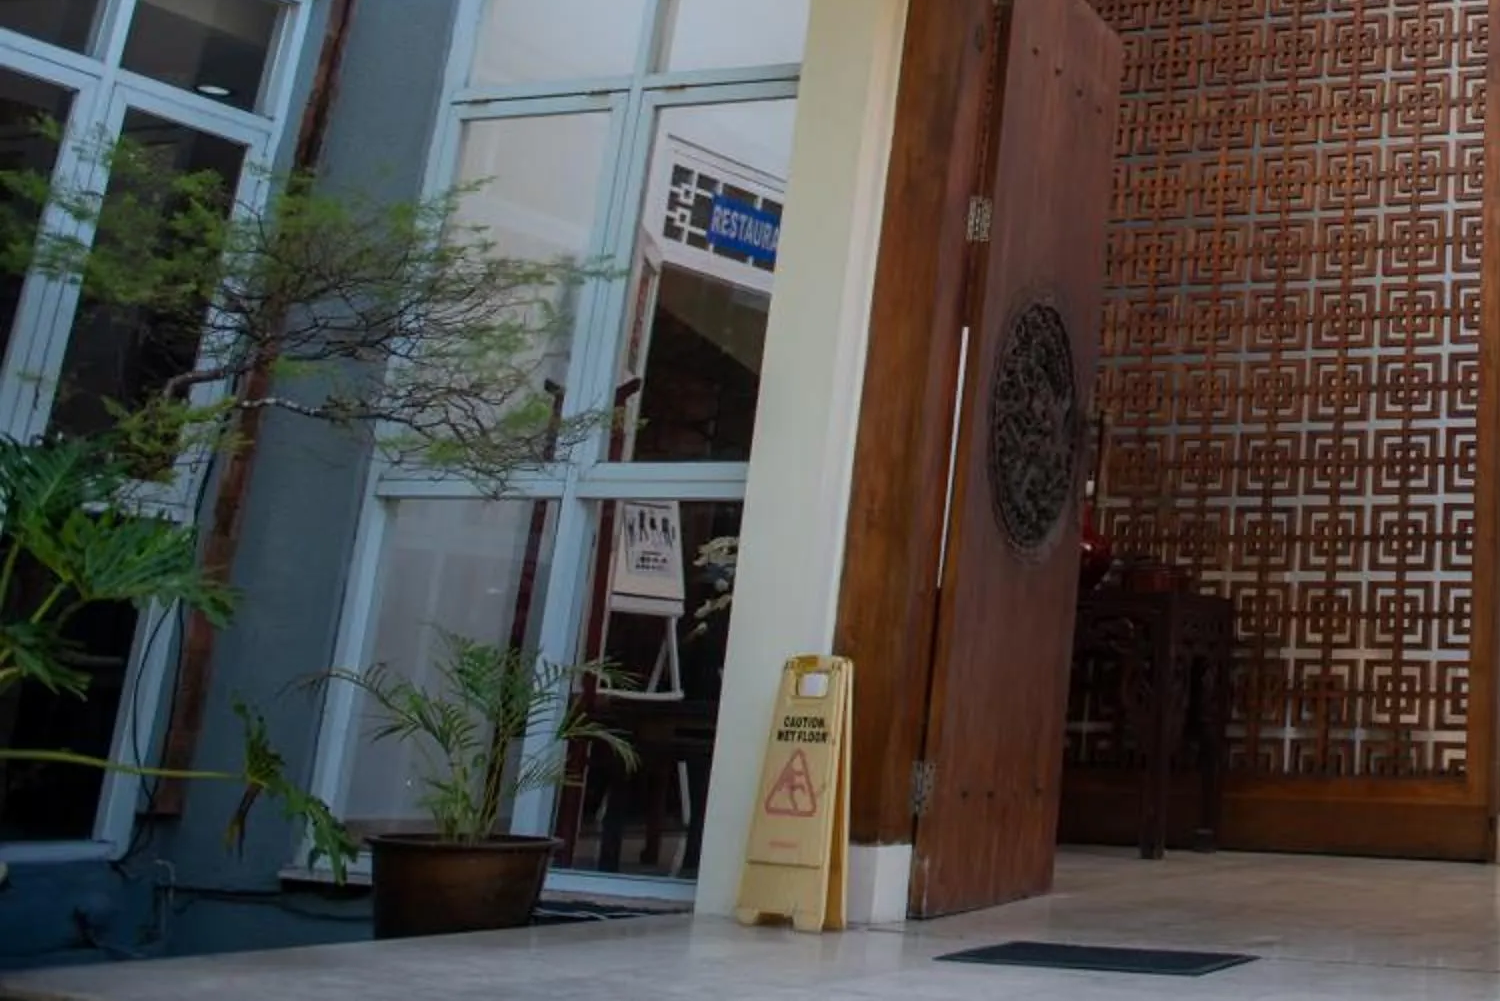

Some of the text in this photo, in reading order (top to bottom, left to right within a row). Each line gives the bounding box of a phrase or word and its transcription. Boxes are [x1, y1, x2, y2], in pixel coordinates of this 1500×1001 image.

[783, 714, 825, 728] CAUTION
[776, 729, 829, 744] WET FLOOR
